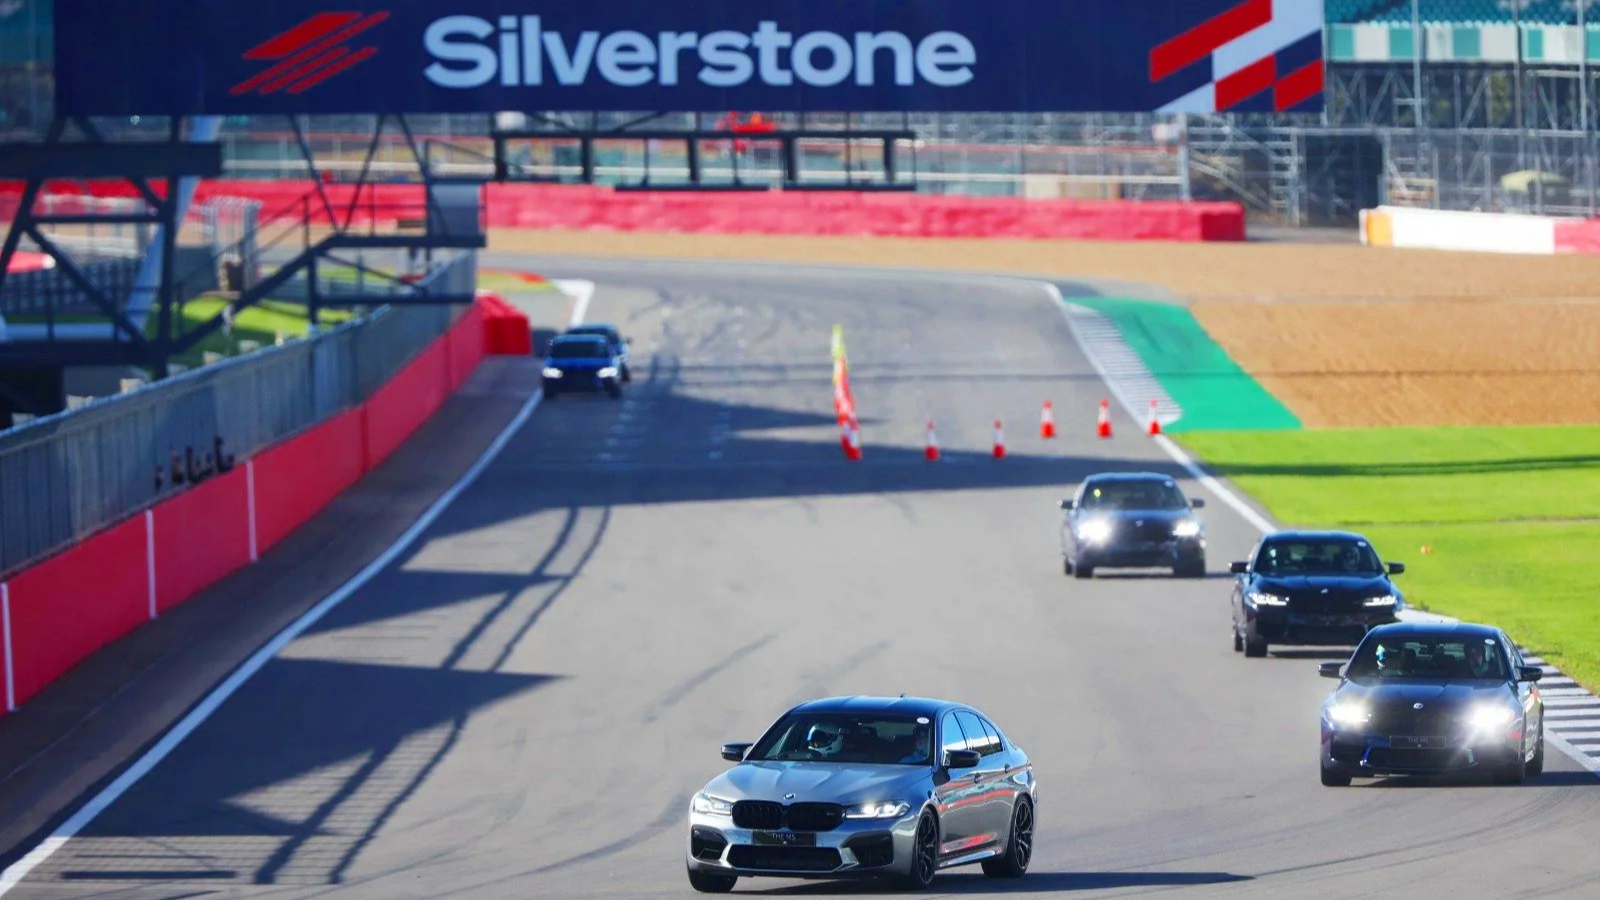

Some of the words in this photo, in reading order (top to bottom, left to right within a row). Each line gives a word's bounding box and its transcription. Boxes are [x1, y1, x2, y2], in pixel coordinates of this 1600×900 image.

[424, 15, 976, 87] Silverstone
[772, 832, 784, 840] THE
[785, 833, 796, 841] M5
